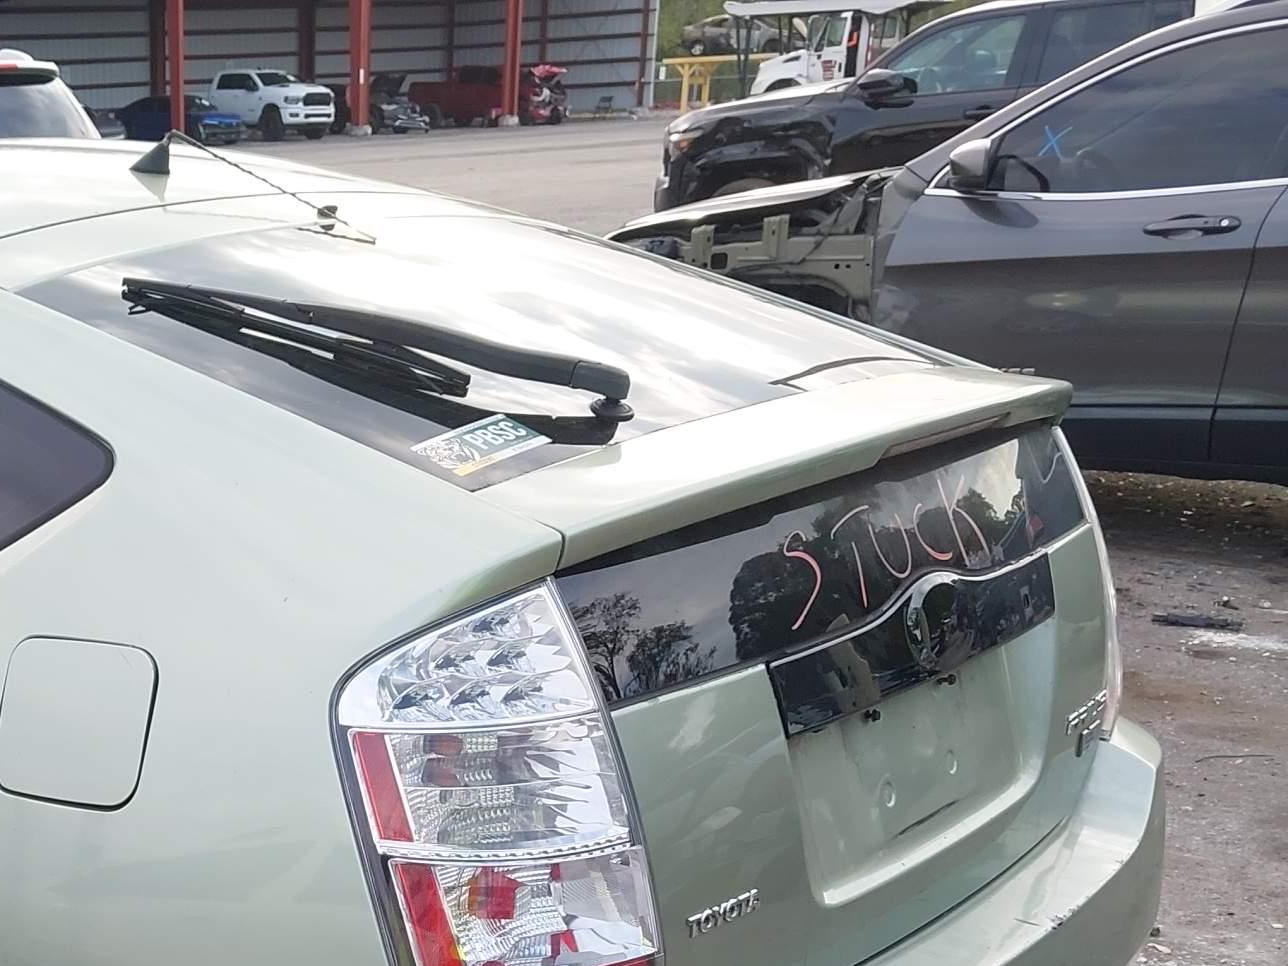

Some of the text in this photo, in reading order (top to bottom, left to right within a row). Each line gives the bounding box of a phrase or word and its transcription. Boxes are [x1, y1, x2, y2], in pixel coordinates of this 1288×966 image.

[462, 421, 528, 451] PBSC
[783, 475, 992, 631] STUCK
[687, 888, 759, 939] TOYOTA
